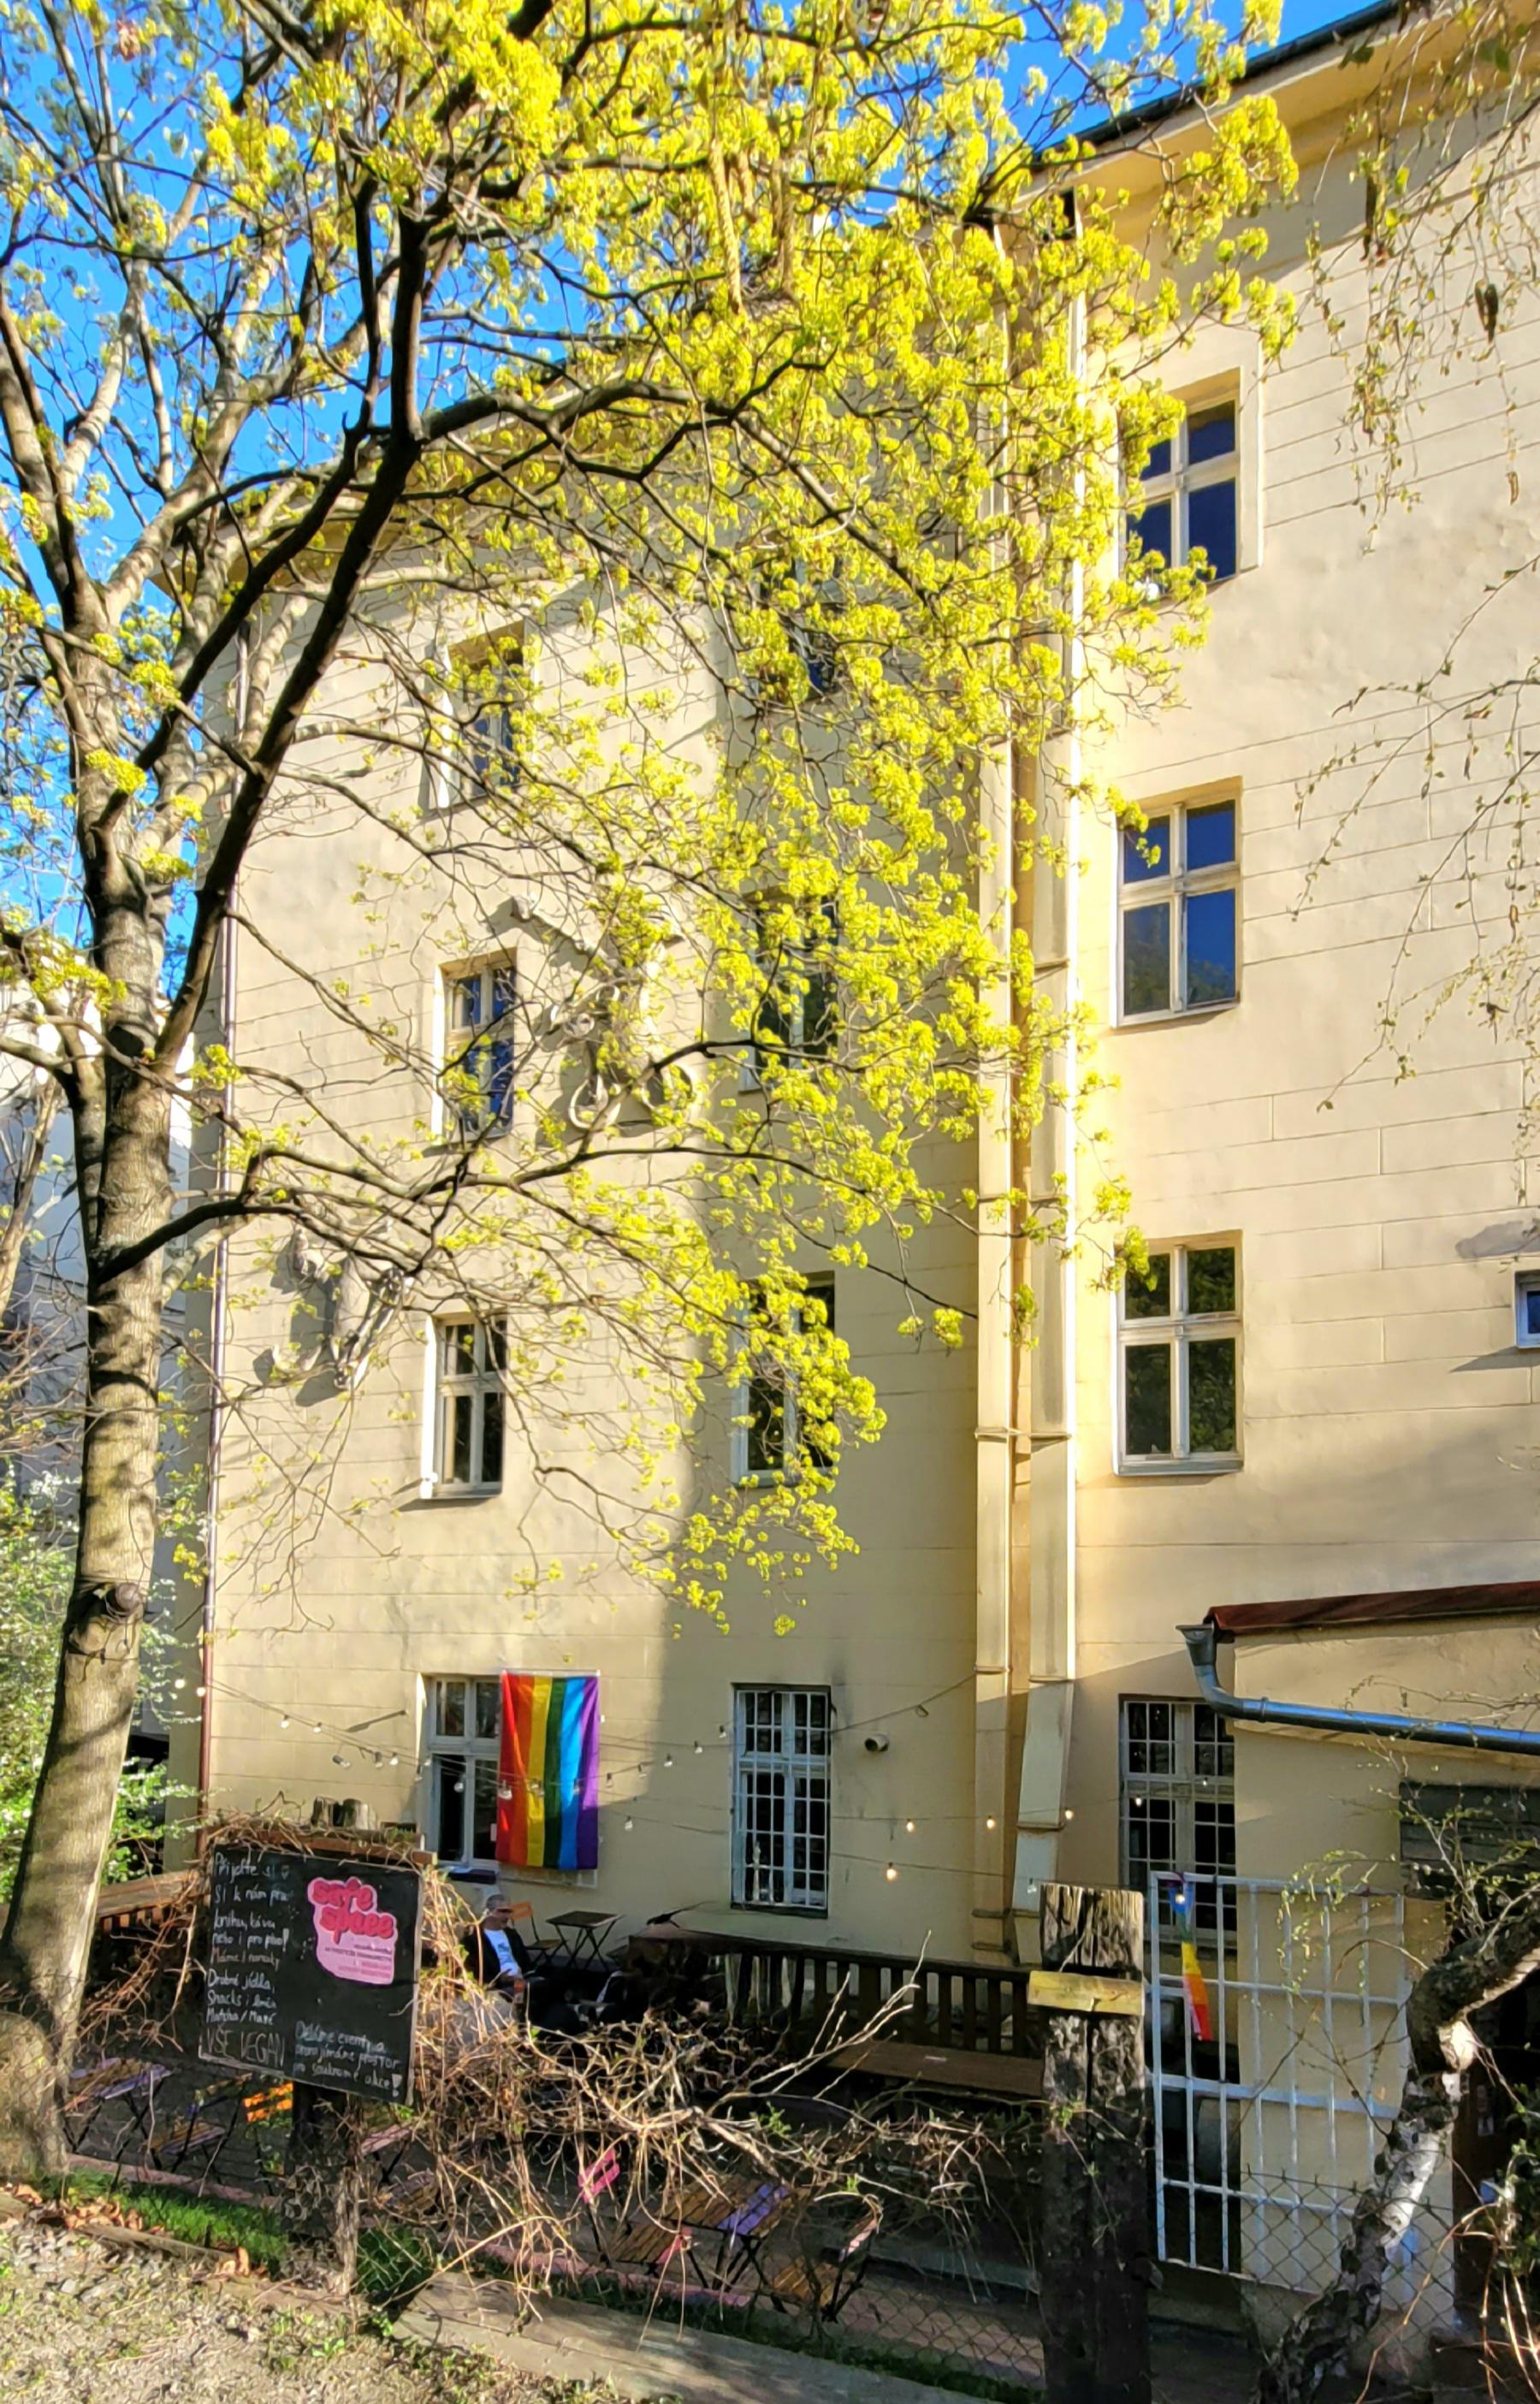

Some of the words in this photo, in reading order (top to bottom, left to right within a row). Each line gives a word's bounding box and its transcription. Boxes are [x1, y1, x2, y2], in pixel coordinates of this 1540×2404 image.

[246, 1883, 267, 1901] nám
[247, 1935, 264, 1950] pro
[240, 2030, 285, 2068] VEGAN
